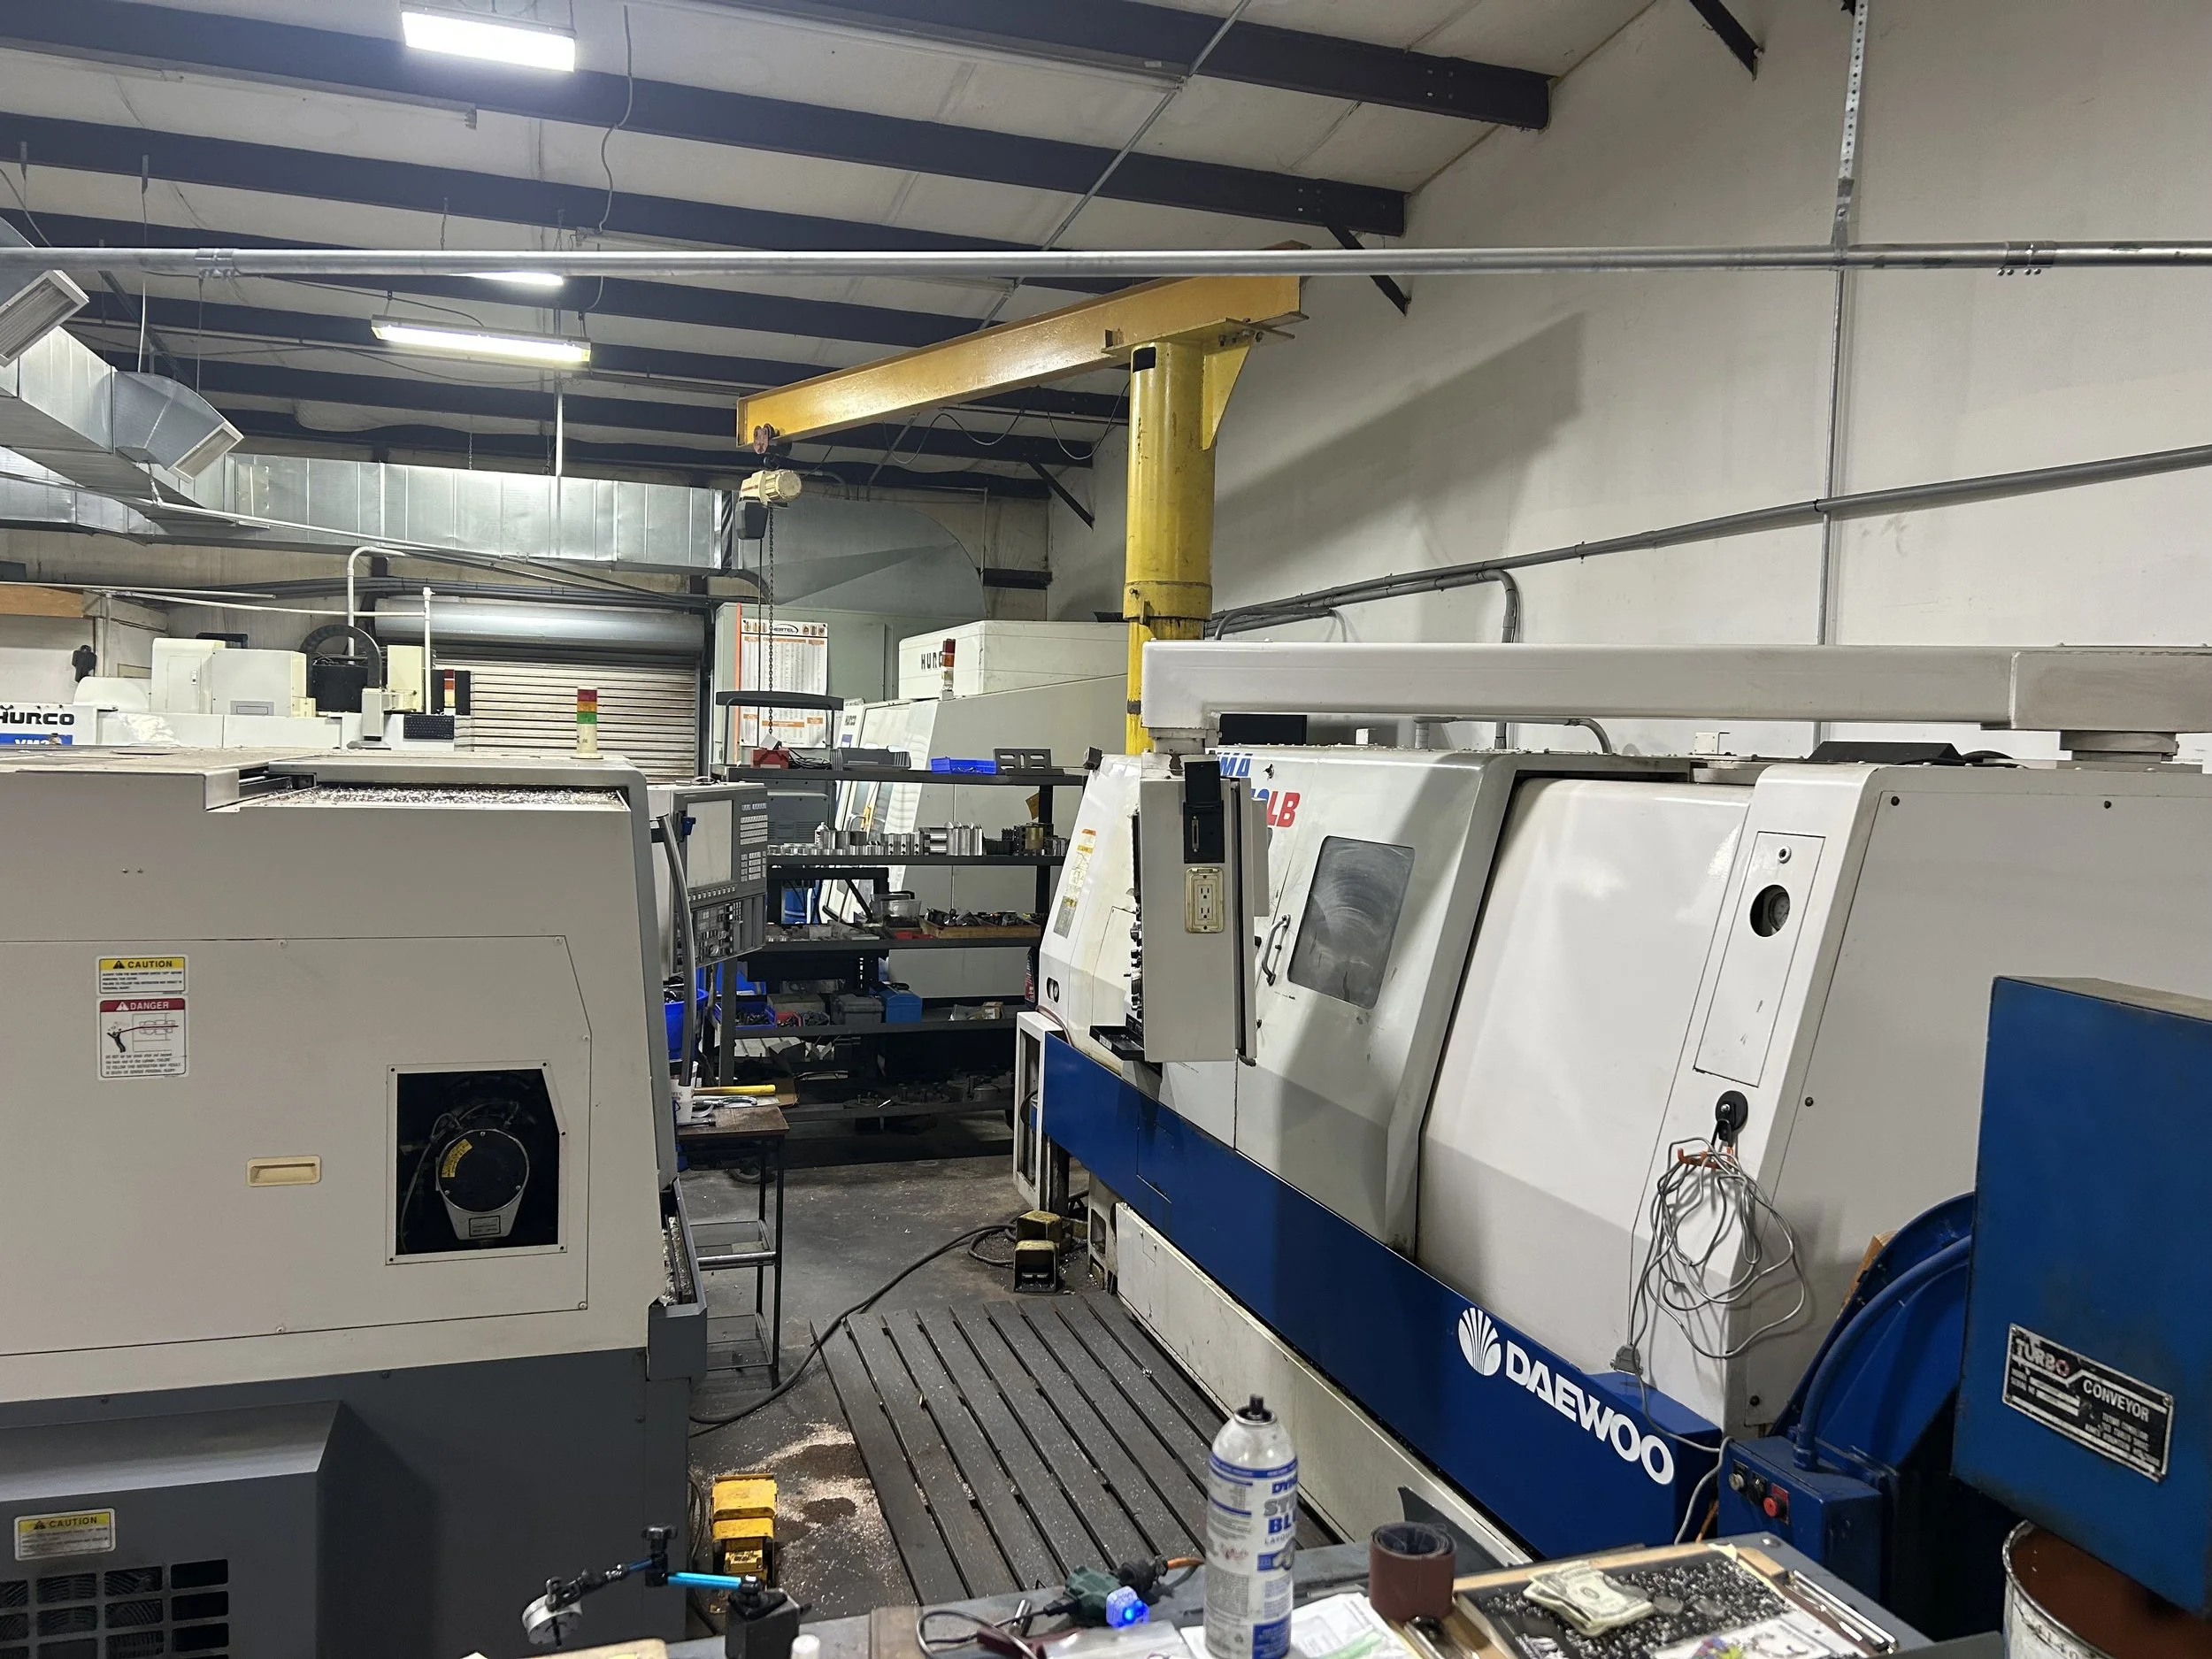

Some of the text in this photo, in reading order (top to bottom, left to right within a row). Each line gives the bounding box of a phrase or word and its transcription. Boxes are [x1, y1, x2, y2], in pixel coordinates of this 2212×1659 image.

[921, 651, 944, 670] HURC
[1218, 757, 1251, 776] MA
[130, 1002, 169, 1010] DANGER
[2014, 1338, 2070, 1377] TURBO
[2083, 1379, 2150, 1423] CONVEYOR
[1506, 1340, 1674, 1485] DAEWOO
[49, 1517, 97, 1529] CAUTION
